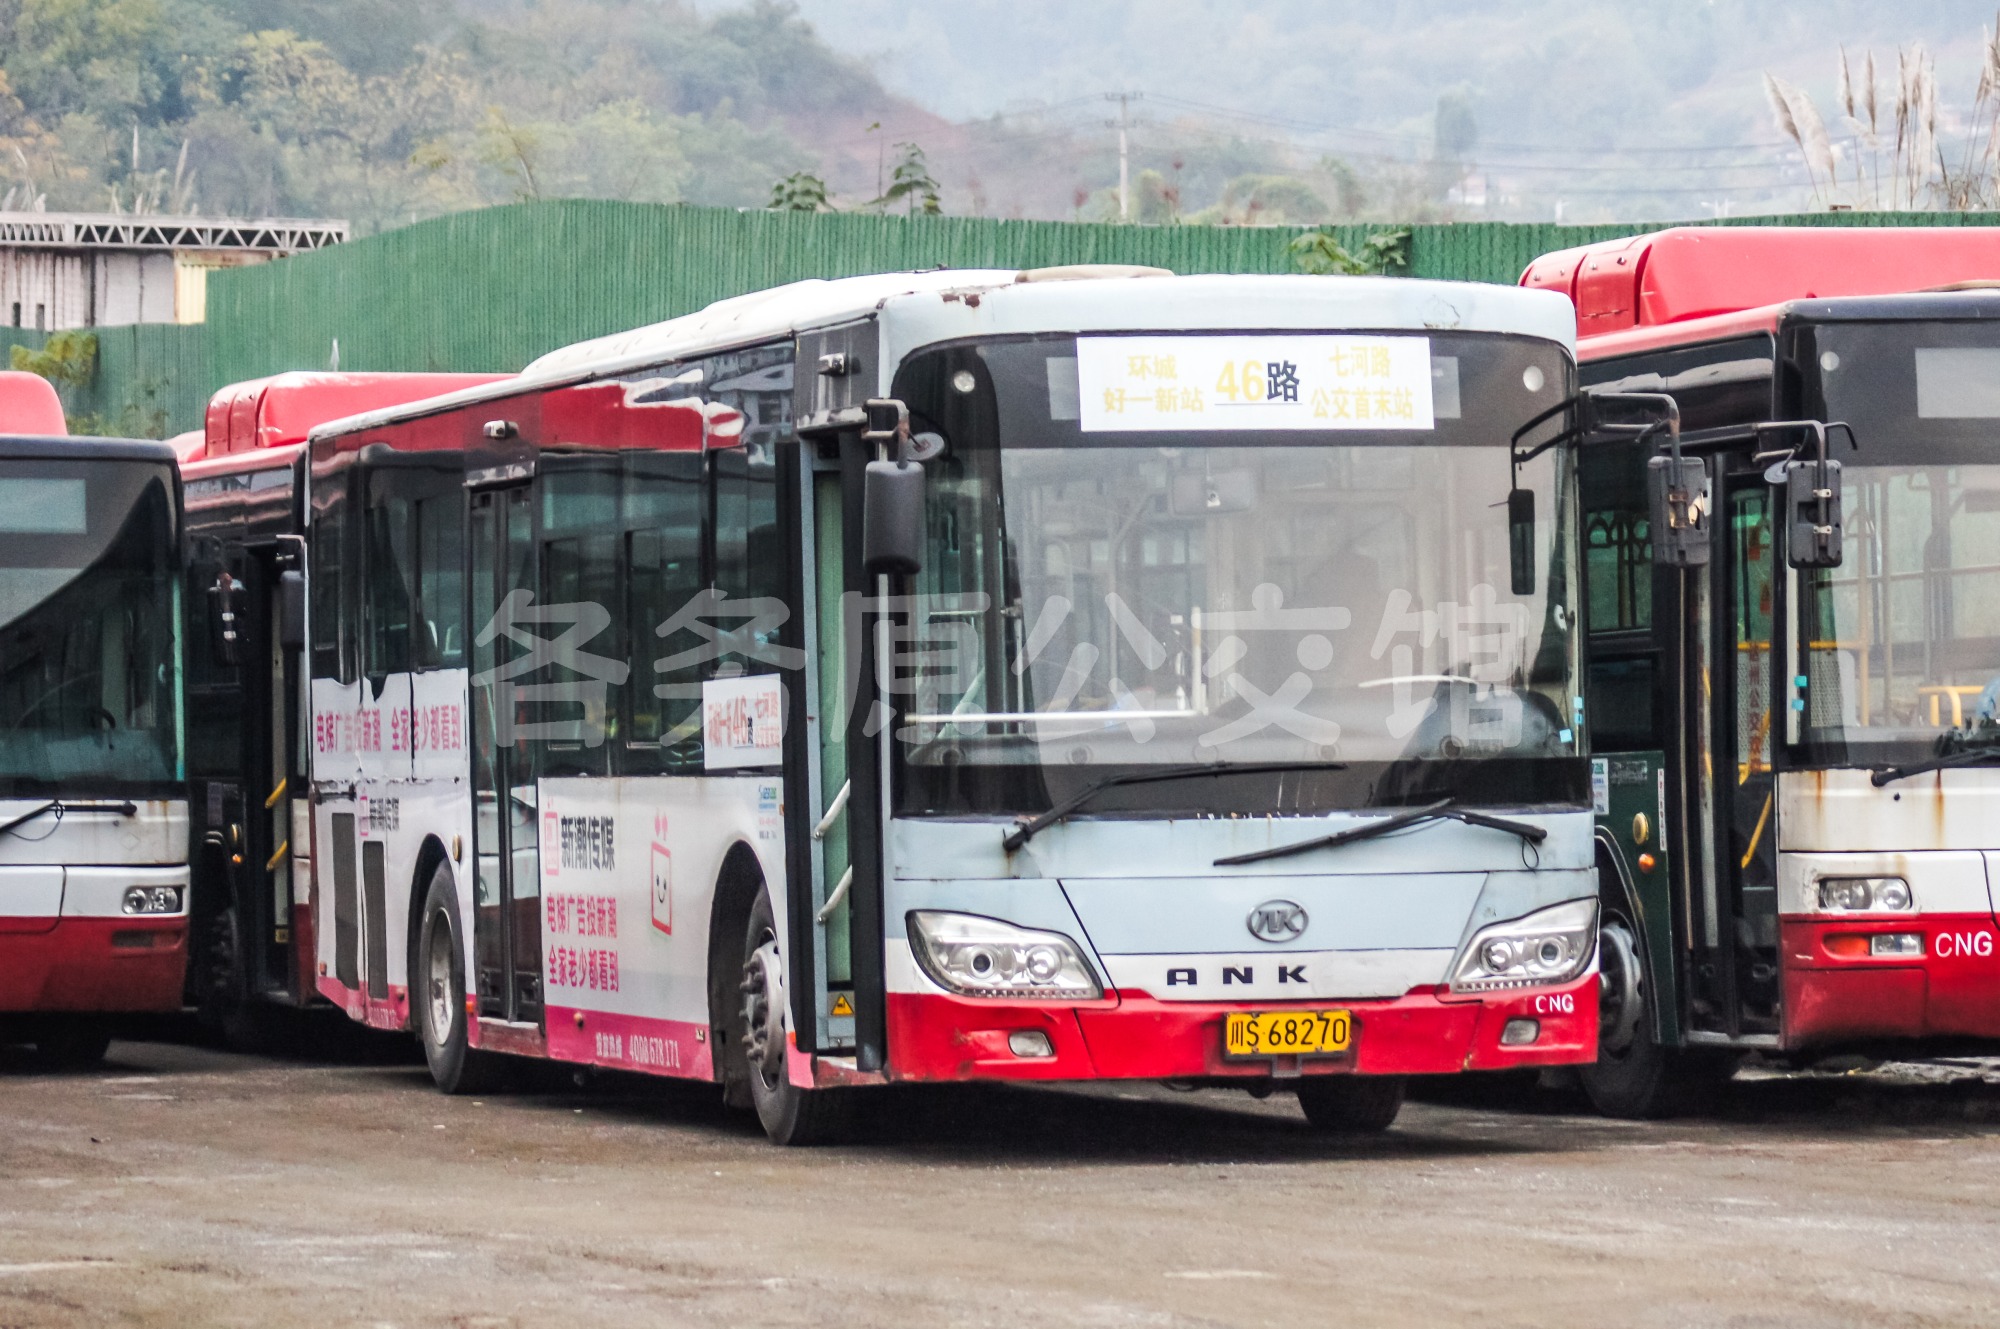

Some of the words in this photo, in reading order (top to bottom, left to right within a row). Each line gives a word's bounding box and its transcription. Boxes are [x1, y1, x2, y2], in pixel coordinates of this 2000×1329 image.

[1127, 355, 1178, 380] 环城
[1329, 344, 1392, 379] 七河路
[1103, 387, 1204, 414] 好一新站
[1310, 386, 1414, 420] 公交首末站
[560, 815, 615, 871] 新潮传媒
[547, 892, 617, 938] 电梯广告投新潮
[1935, 930, 1993, 958] CNG
[549, 944, 619, 993] 全家老少都看到
[1535, 993, 1574, 1014] CNG
